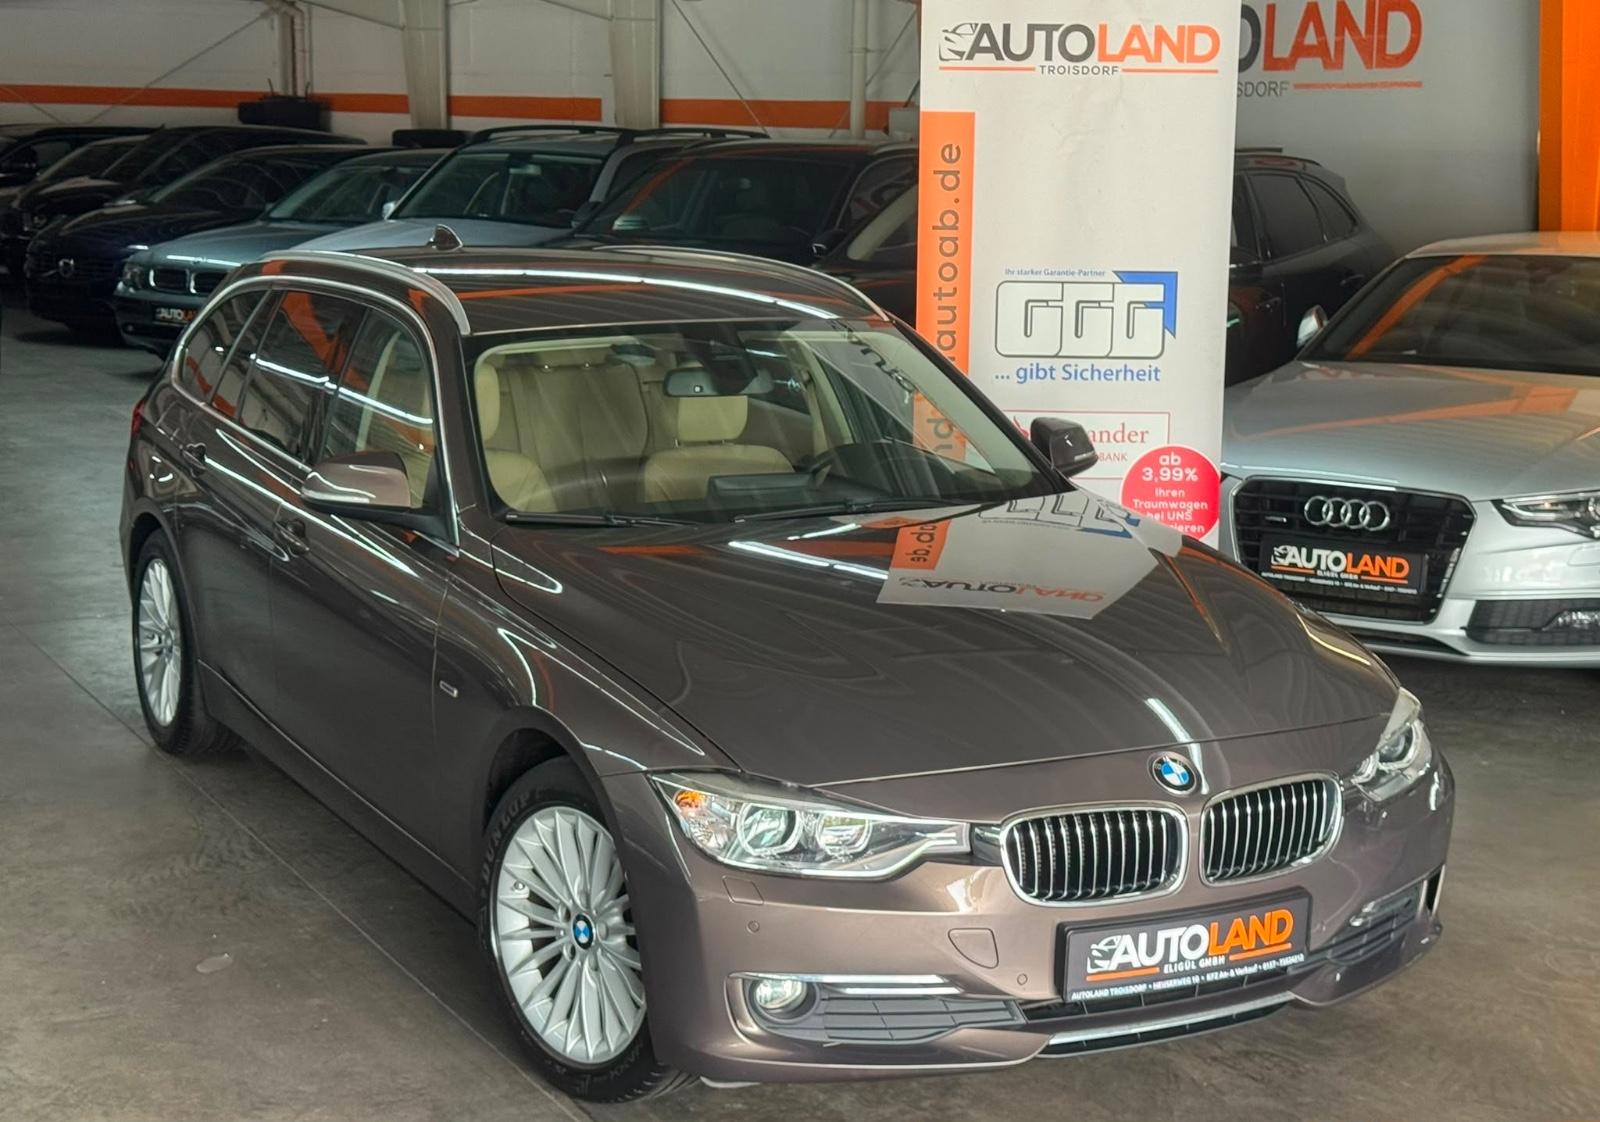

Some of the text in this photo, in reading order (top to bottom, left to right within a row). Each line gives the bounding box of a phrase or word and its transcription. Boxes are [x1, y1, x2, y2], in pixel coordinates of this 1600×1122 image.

[964, 22, 1221, 64] AUTOLAND
[1039, 64, 1120, 76] TROISDORF
[1237, 80, 1289, 97] SDORF
[932, 143, 961, 363] autoab.de
[1017, 268, 1042, 277] starker
[1043, 268, 1106, 278] Garantie-Partner
[1016, 363, 1056, 384] gibt
[1061, 363, 1161, 382] Sicherheit
[1089, 422, 1149, 444] ander
[1159, 452, 1182, 466] ab
[1154, 487, 1185, 498] Ihren
[1132, 498, 1209, 513] Traumwagen
[1166, 510, 1193, 521] UNS
[1285, 545, 1410, 579] AUTOLAND
[1109, 908, 1294, 971] AUTOLAND
[1199, 956, 1226, 970] GMBH
